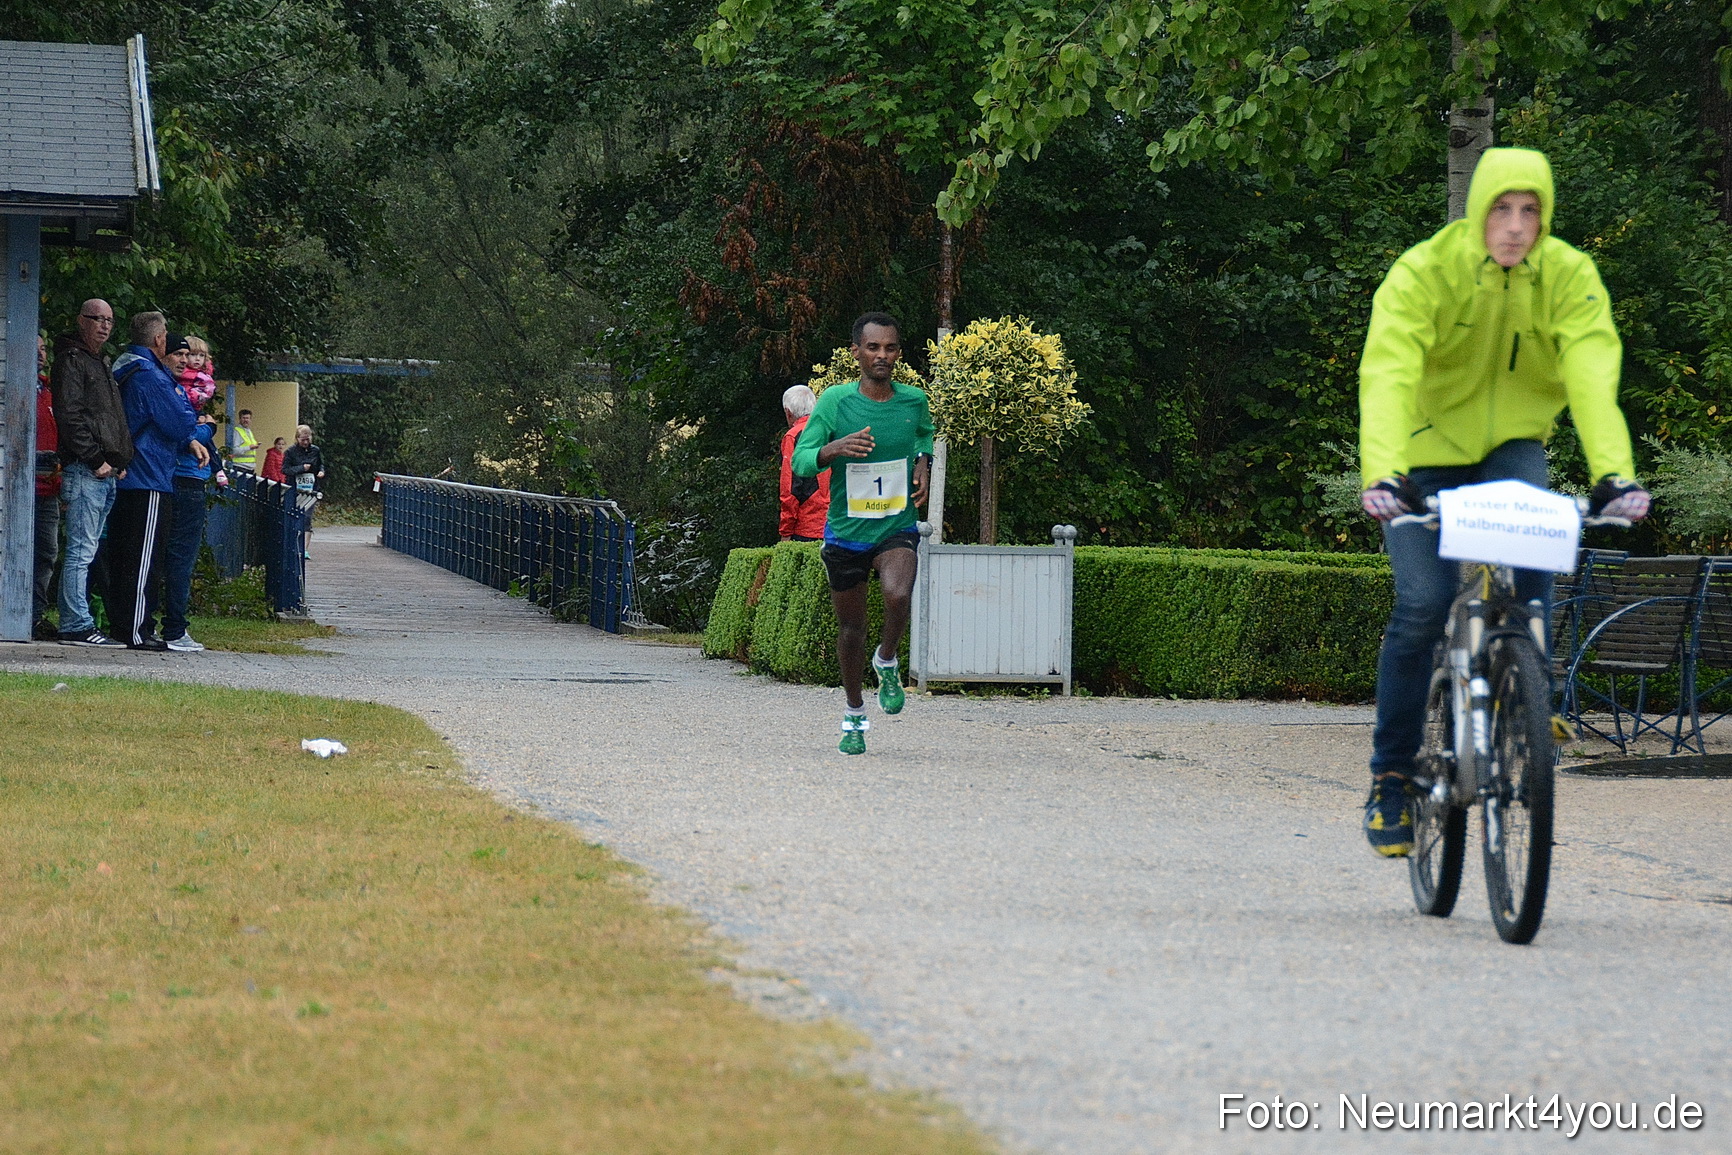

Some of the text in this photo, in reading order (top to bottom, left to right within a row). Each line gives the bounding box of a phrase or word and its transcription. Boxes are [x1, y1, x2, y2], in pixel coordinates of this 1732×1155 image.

[873, 476, 883, 496] 1
[1463, 500, 1559, 515] Erster Mann
[1456, 516, 1567, 539] Halbmarathon
